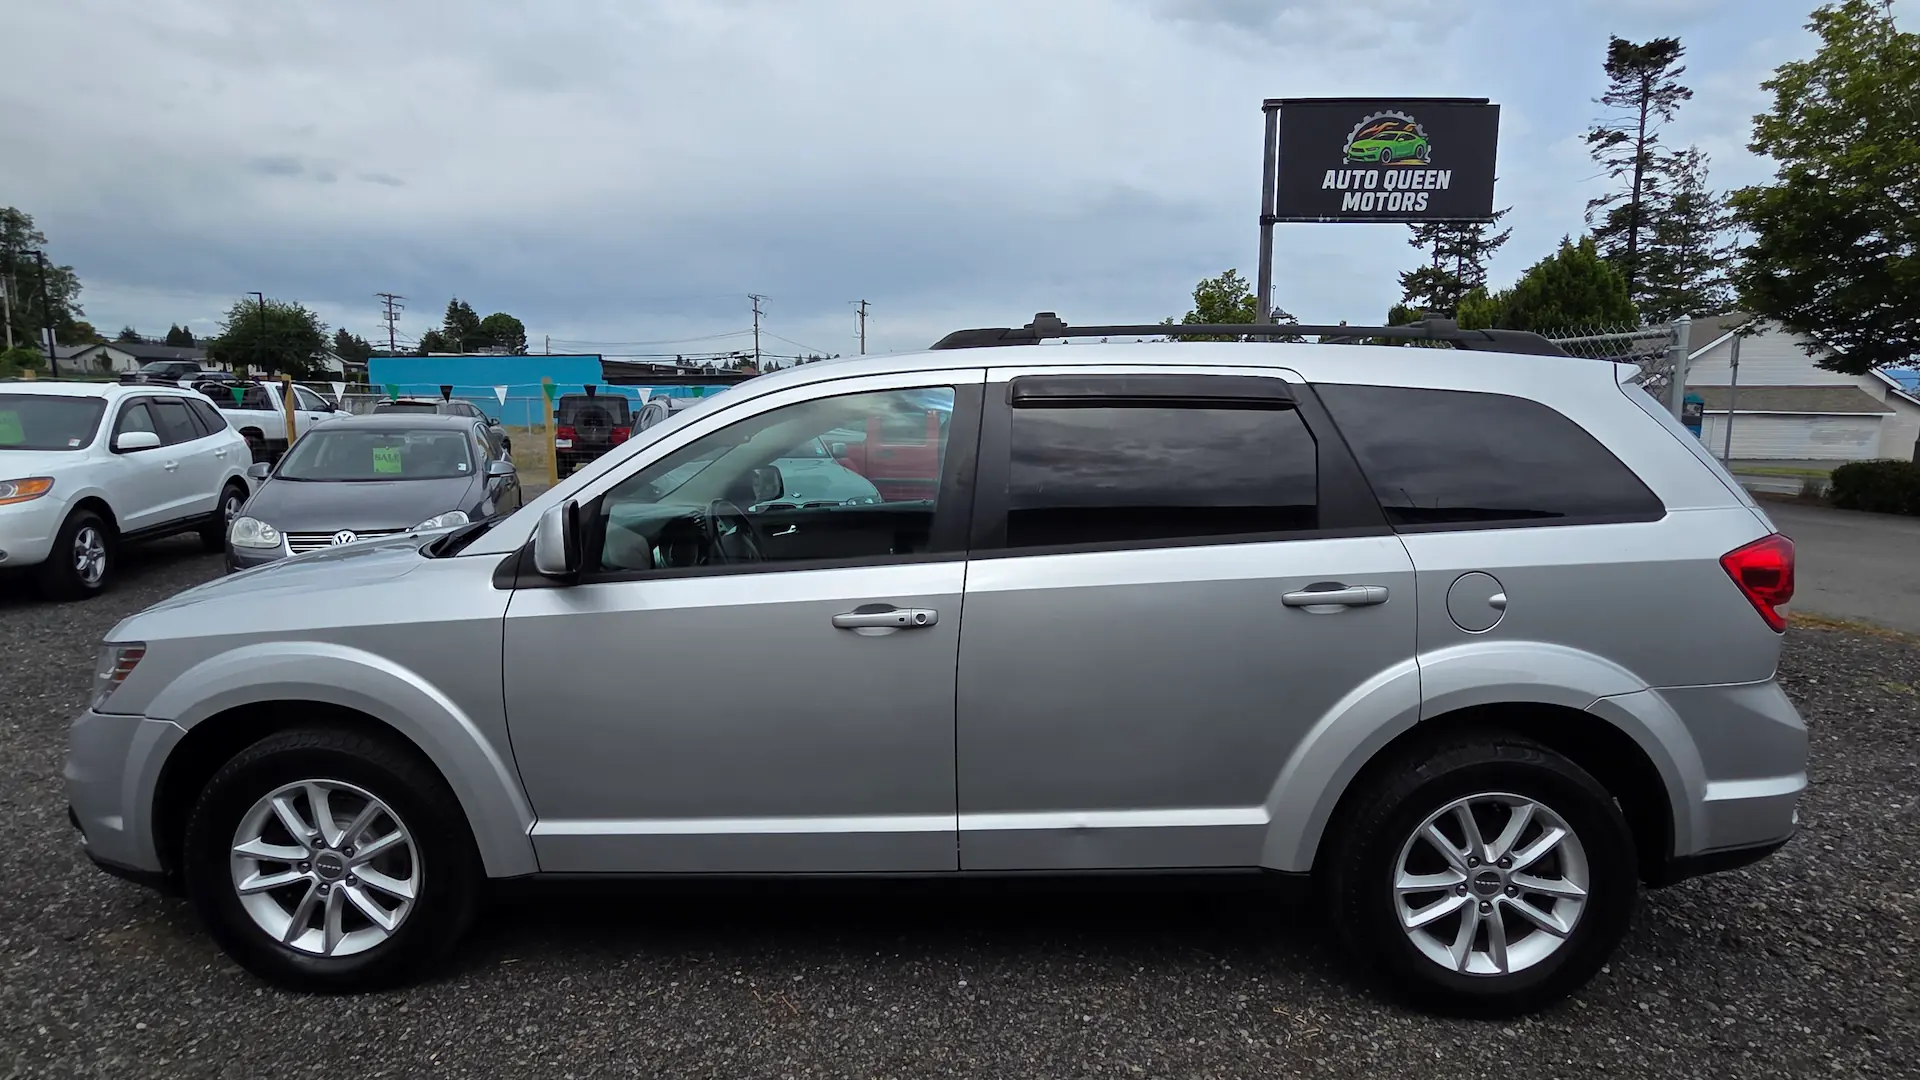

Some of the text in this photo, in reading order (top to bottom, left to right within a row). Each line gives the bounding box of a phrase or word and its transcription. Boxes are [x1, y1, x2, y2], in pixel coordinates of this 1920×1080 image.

[1322, 170, 1452, 191] AUTO QUEEN
[1341, 191, 1429, 212] MOTORS
